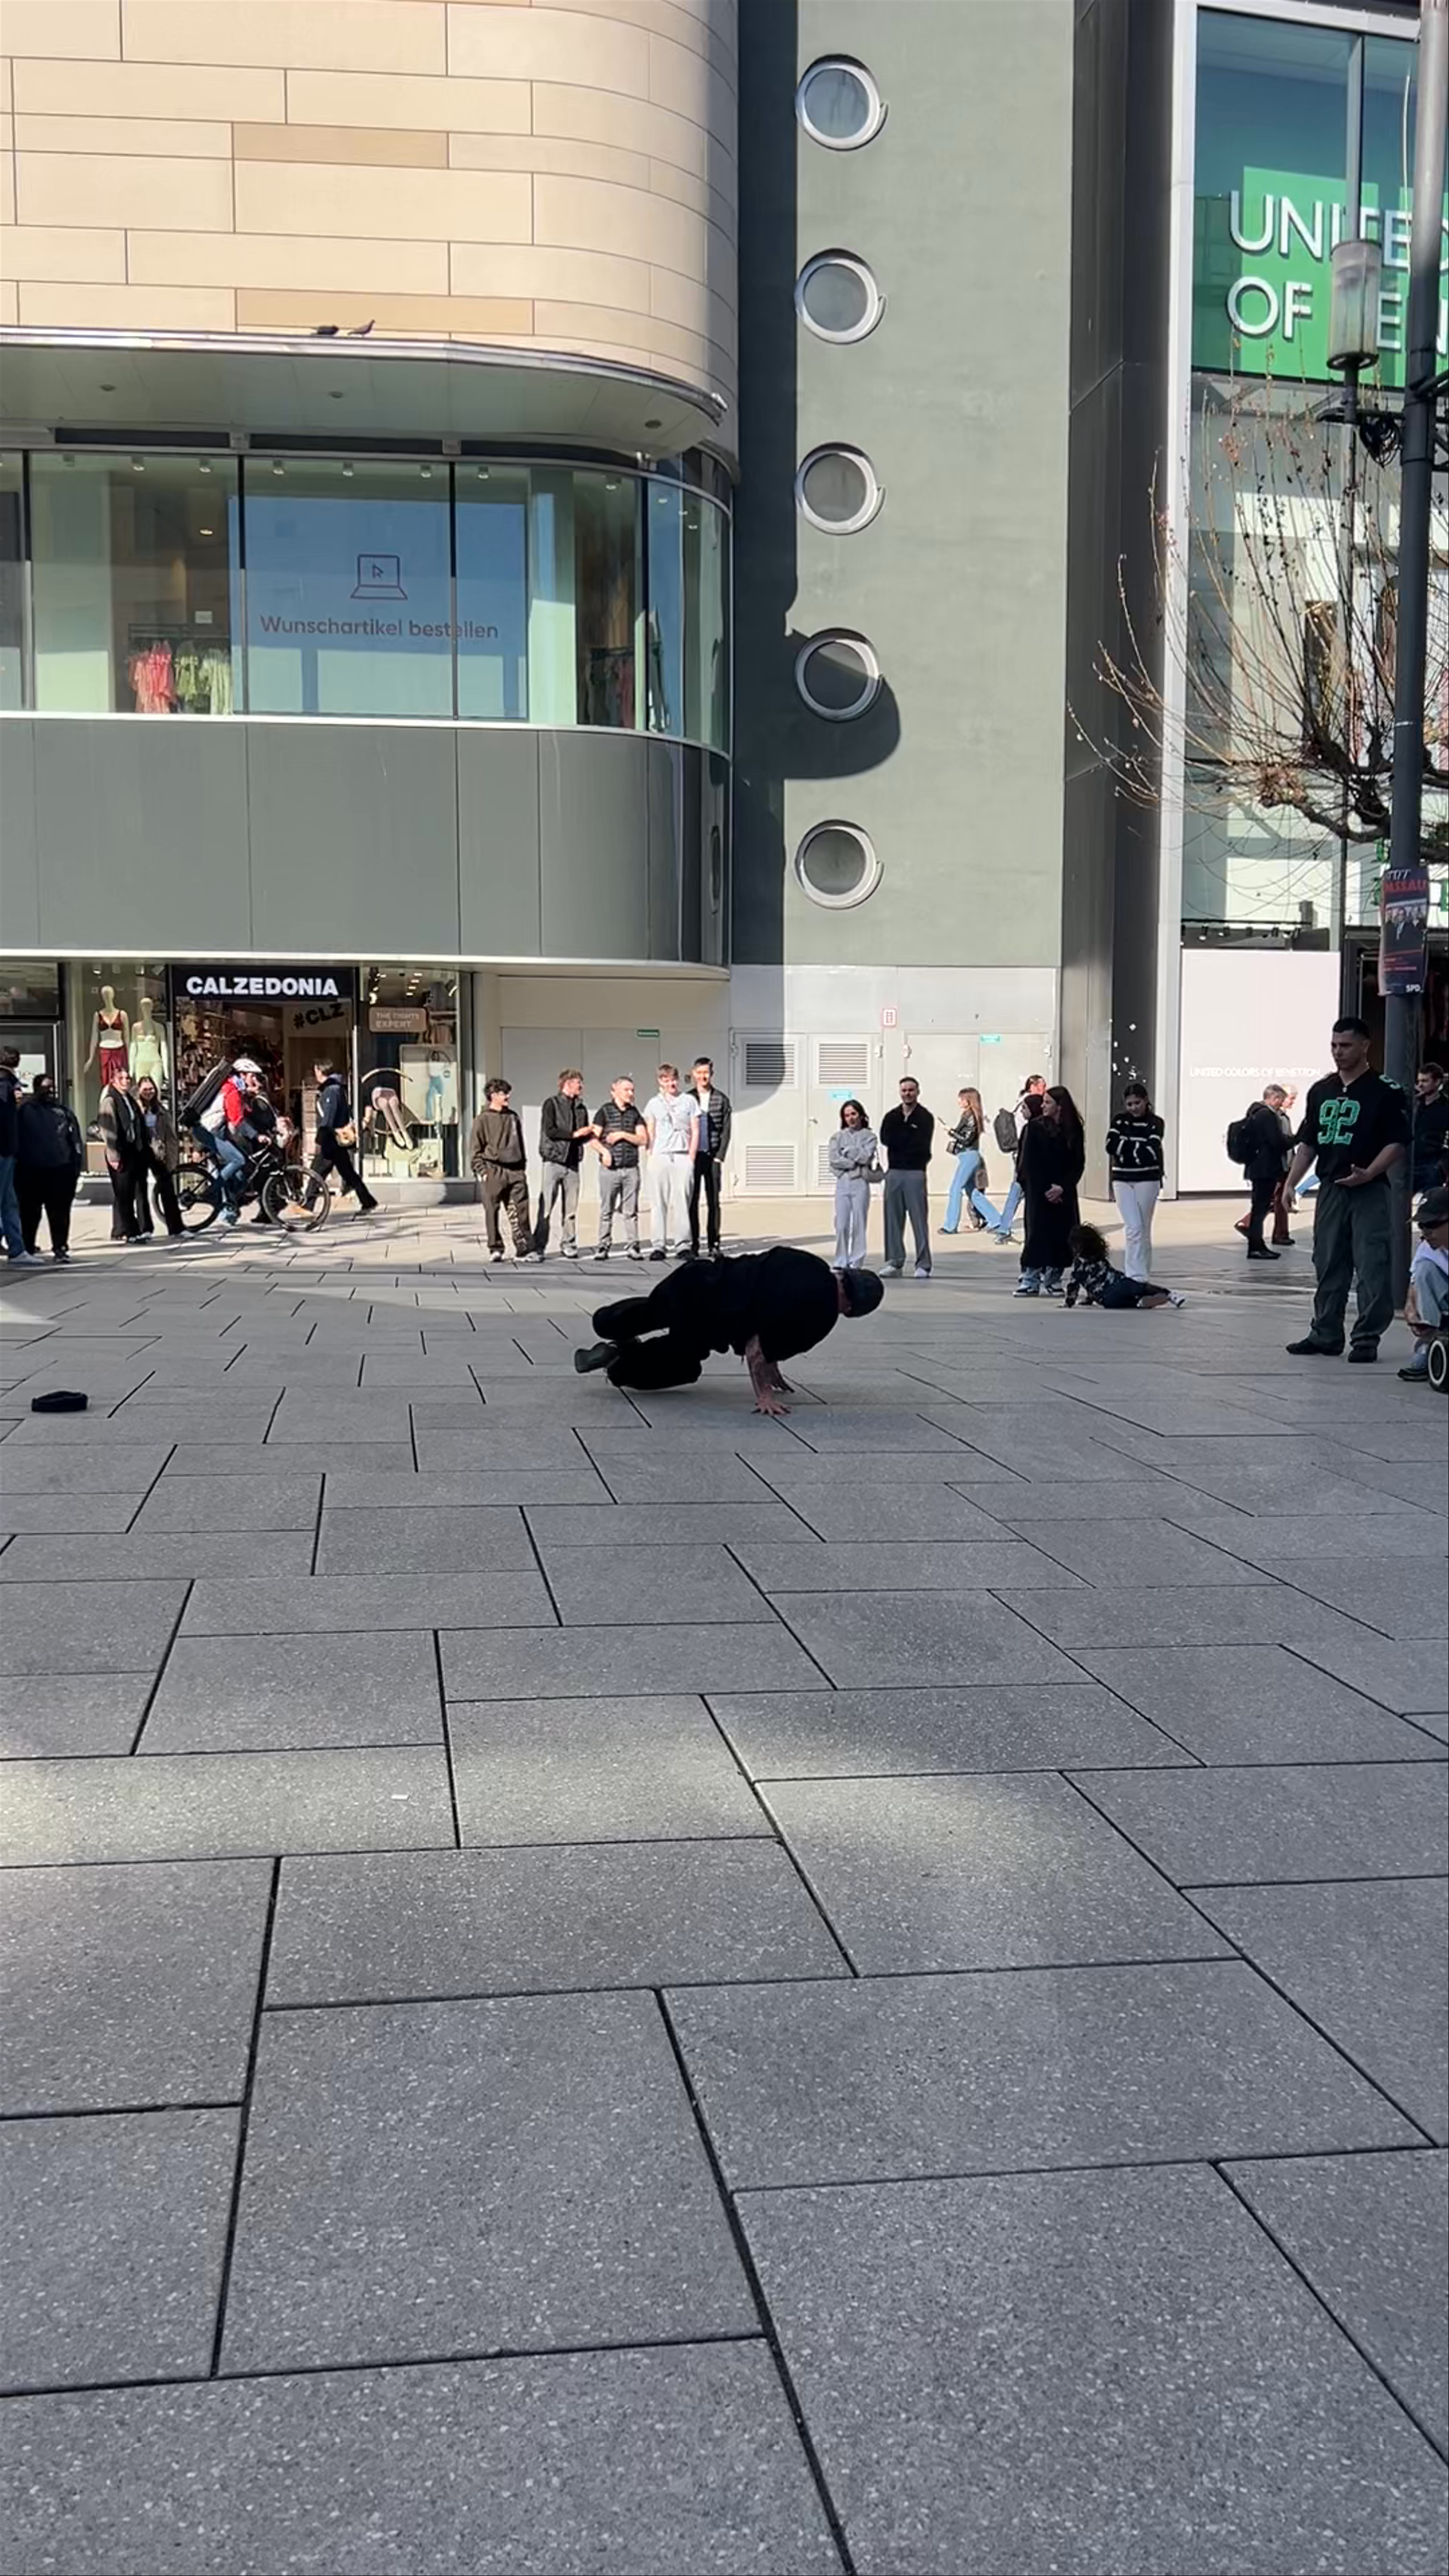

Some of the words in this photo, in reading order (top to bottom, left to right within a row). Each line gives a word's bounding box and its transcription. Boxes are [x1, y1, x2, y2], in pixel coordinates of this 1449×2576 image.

[1231, 191, 1448, 271] UNIE
[1227, 277, 1312, 338] OF
[261, 615, 402, 637] Wunschartikel
[409, 620, 498, 639] bestellen
[186, 977, 338, 995] CALZEDONIA
[293, 1003, 345, 1030] #CLZ
[1190, 1067, 1223, 1077] UNITED
[1224, 1067, 1261, 1077] COLORS
[1262, 1067, 1274, 1077] OF
[1317, 1100, 1360, 1145] 92
